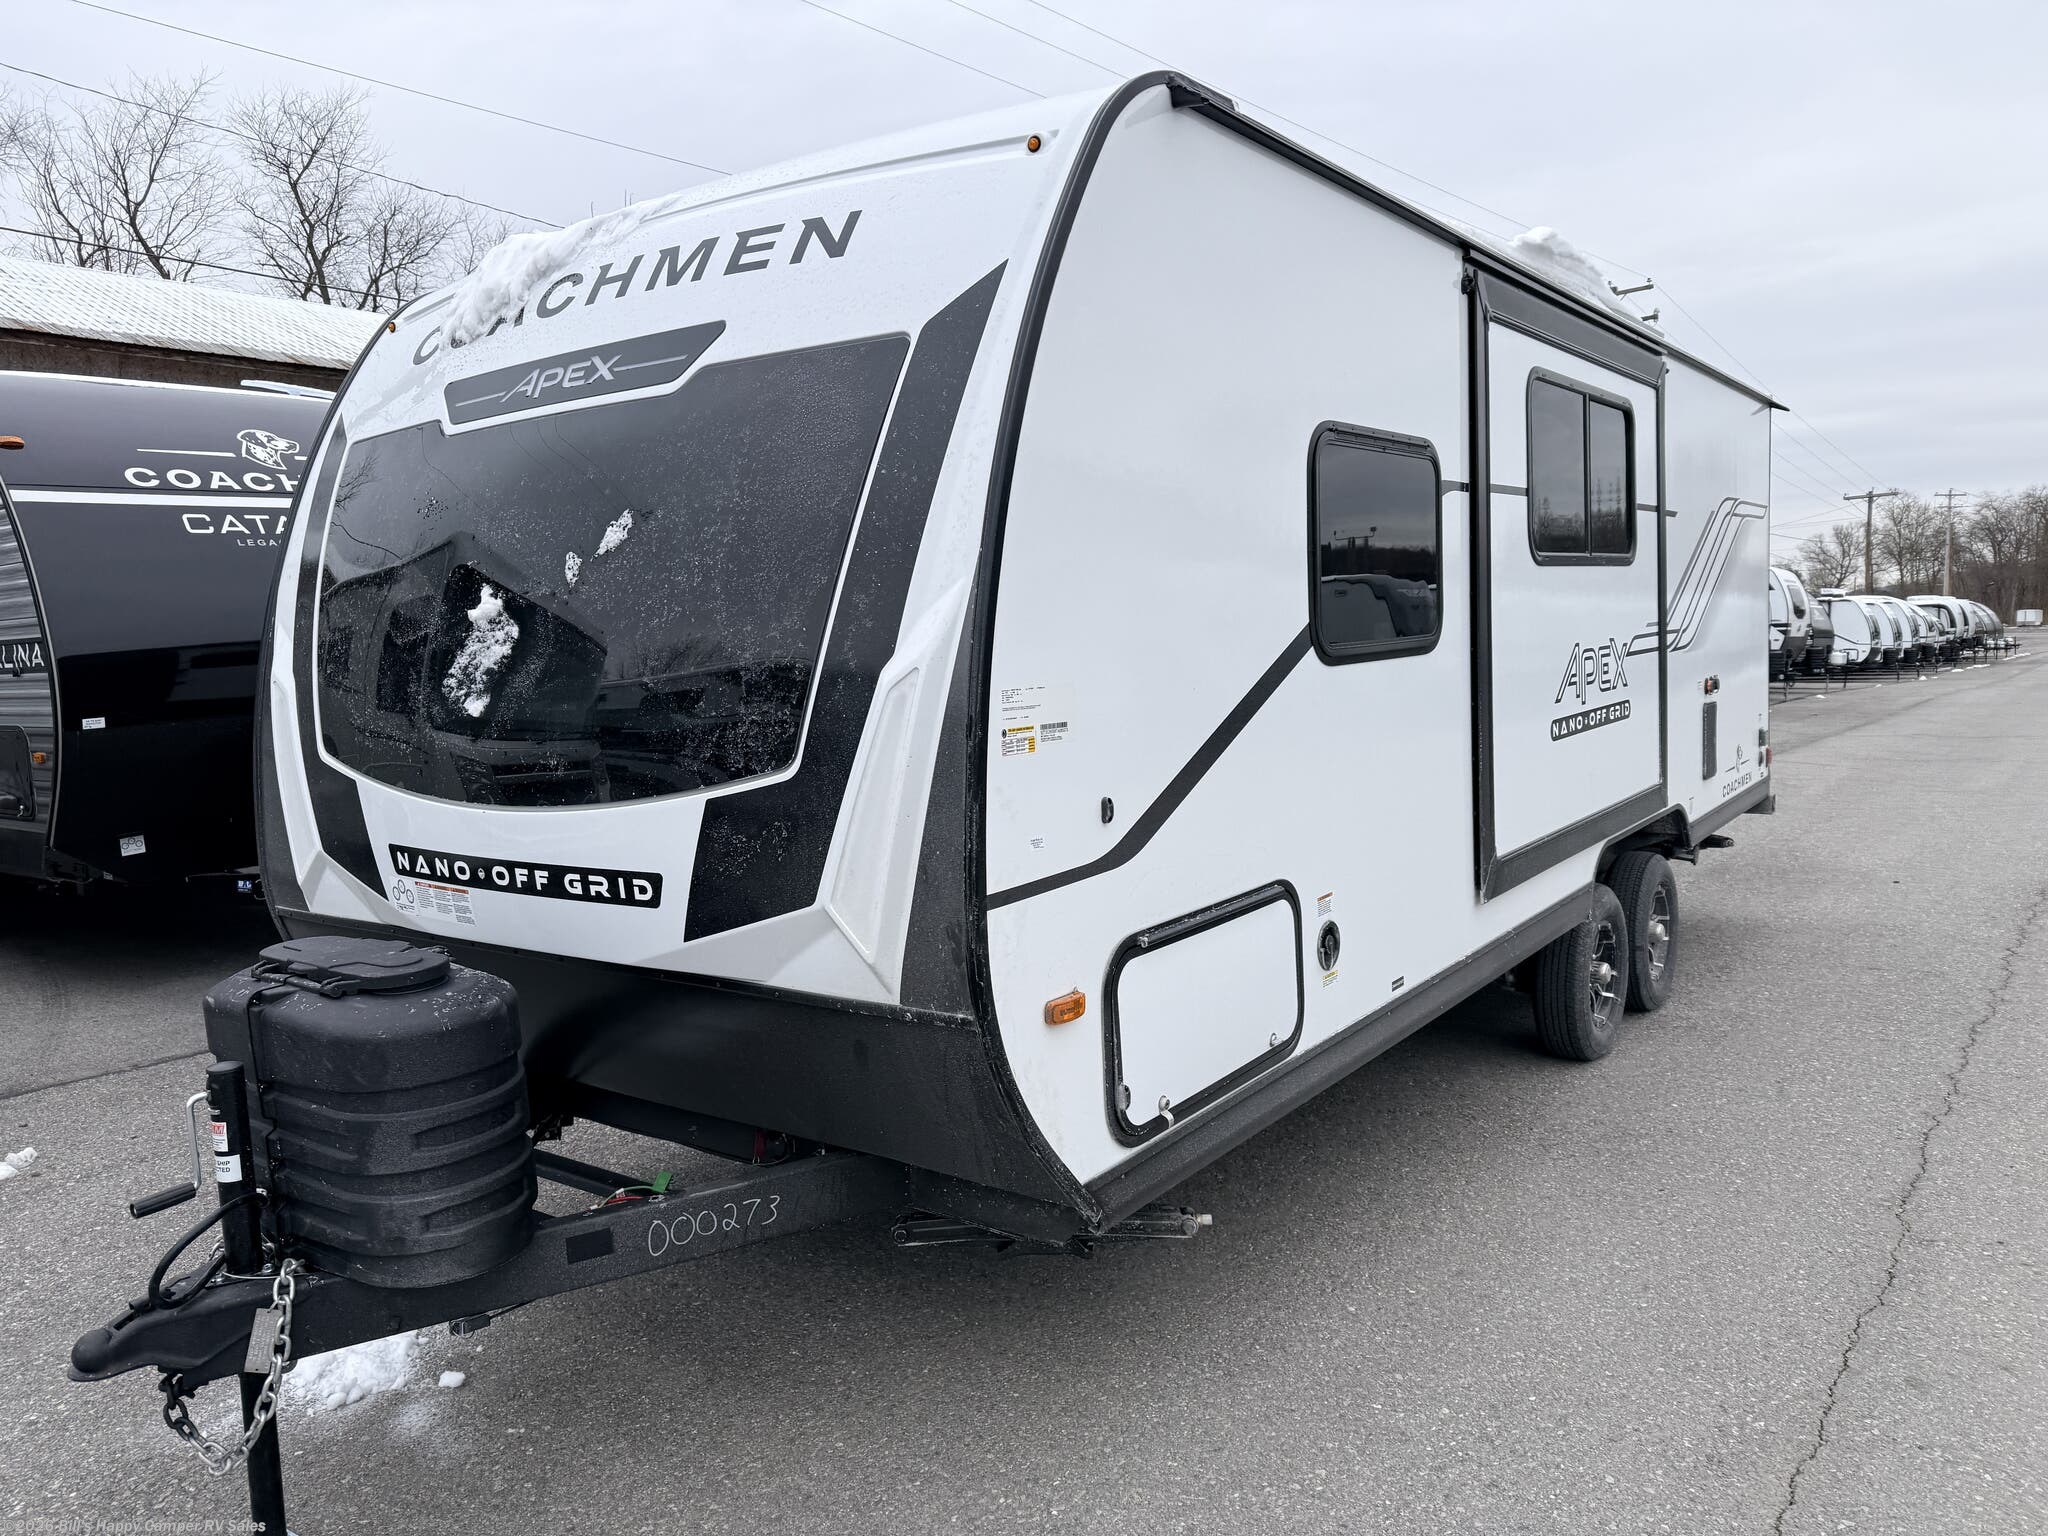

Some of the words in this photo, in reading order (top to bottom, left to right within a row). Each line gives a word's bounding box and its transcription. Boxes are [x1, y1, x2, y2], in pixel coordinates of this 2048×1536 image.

[413, 210, 862, 365] CCHMEN
[500, 352, 622, 402] APEX
[236, 539, 282, 547] LEGA
[0, 642, 45, 668] LINA
[1555, 637, 1628, 705] APEX
[1552, 715, 1583, 737] NANO
[1589, 708, 1607, 726] OFF
[1609, 702, 1630, 720] GRID
[1722, 772, 1753, 798] COACHMEN
[396, 851, 471, 881] NANO
[491, 865, 549, 891] OFF
[563, 873, 654, 901] GRID
[648, 1195, 781, 1256] 000273
